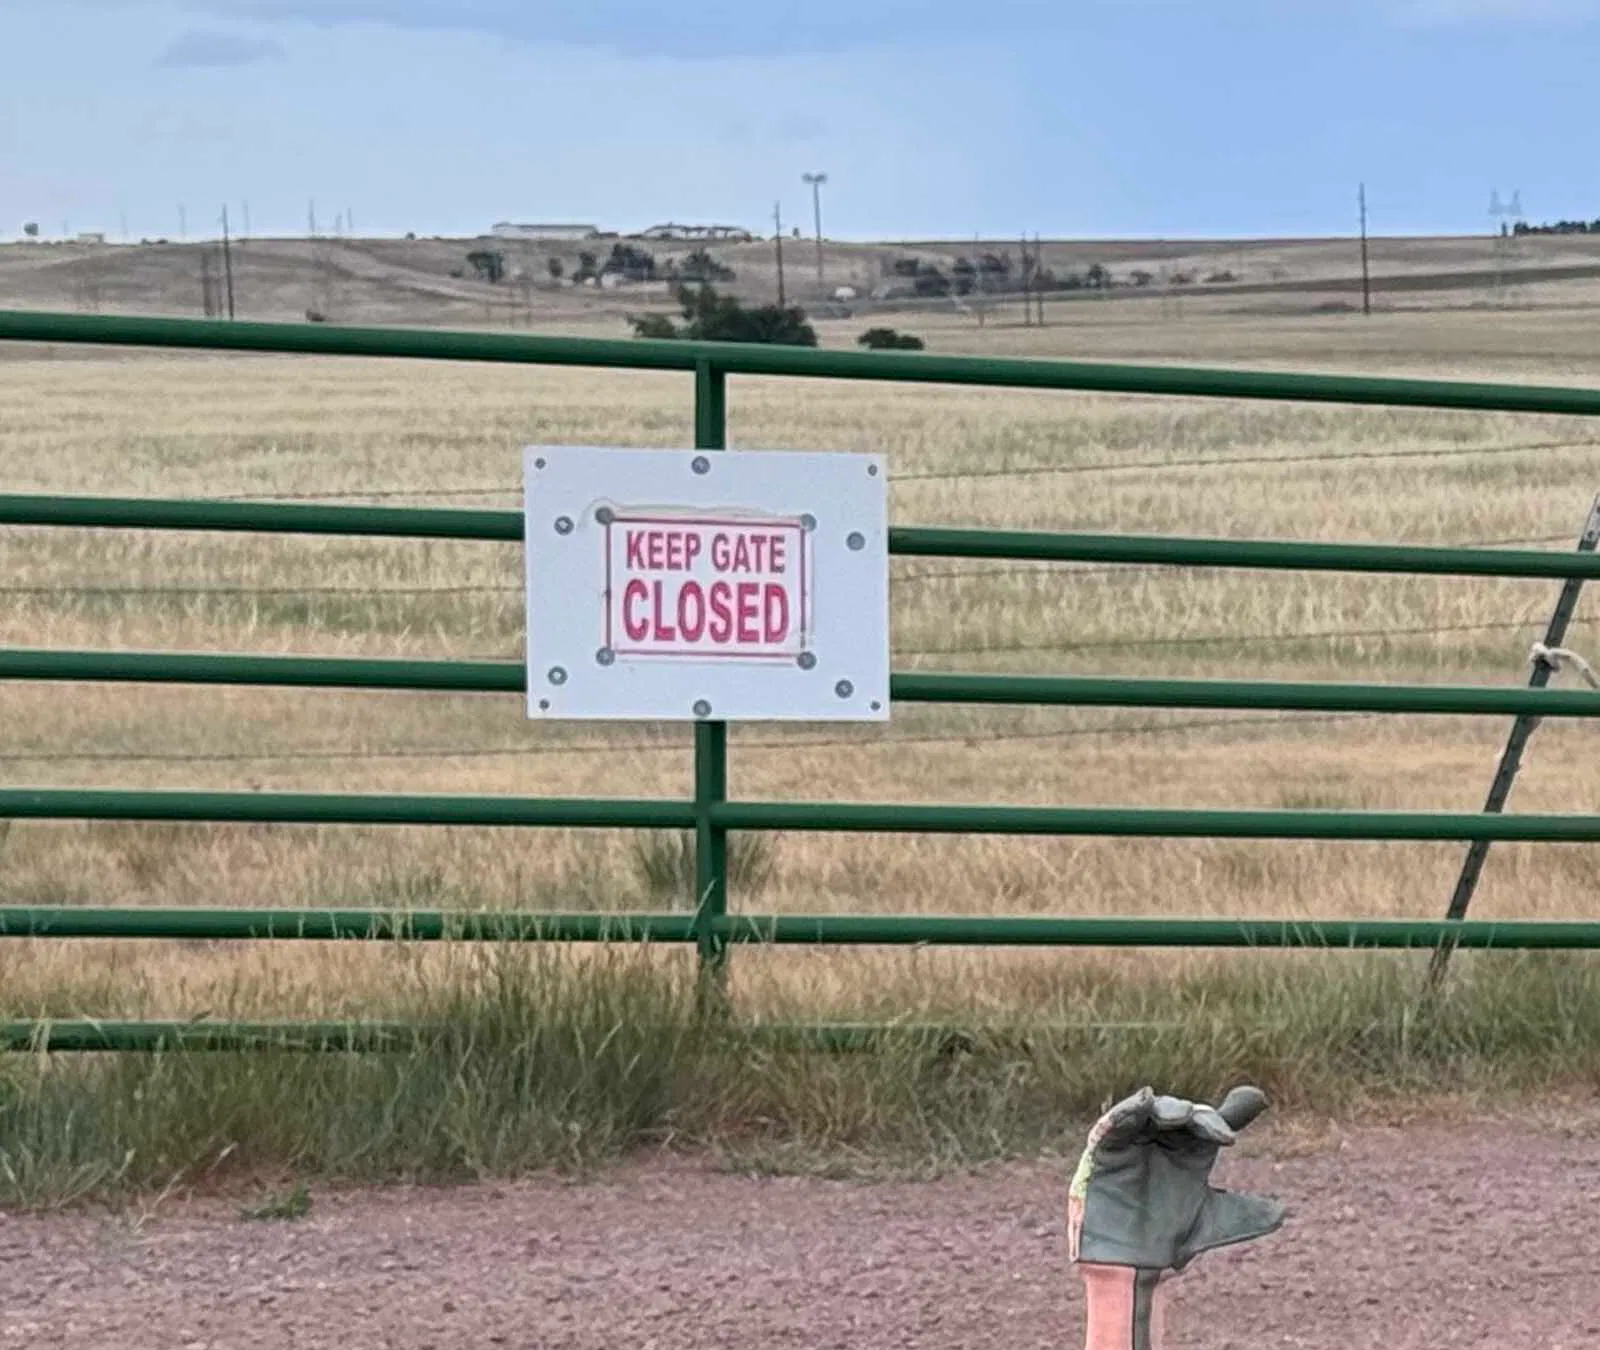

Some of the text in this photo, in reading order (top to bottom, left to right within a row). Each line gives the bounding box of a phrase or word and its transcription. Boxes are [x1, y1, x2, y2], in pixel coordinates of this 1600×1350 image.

[625, 531, 786, 574] KEEP GATE
[622, 578, 790, 644] CLOSED
